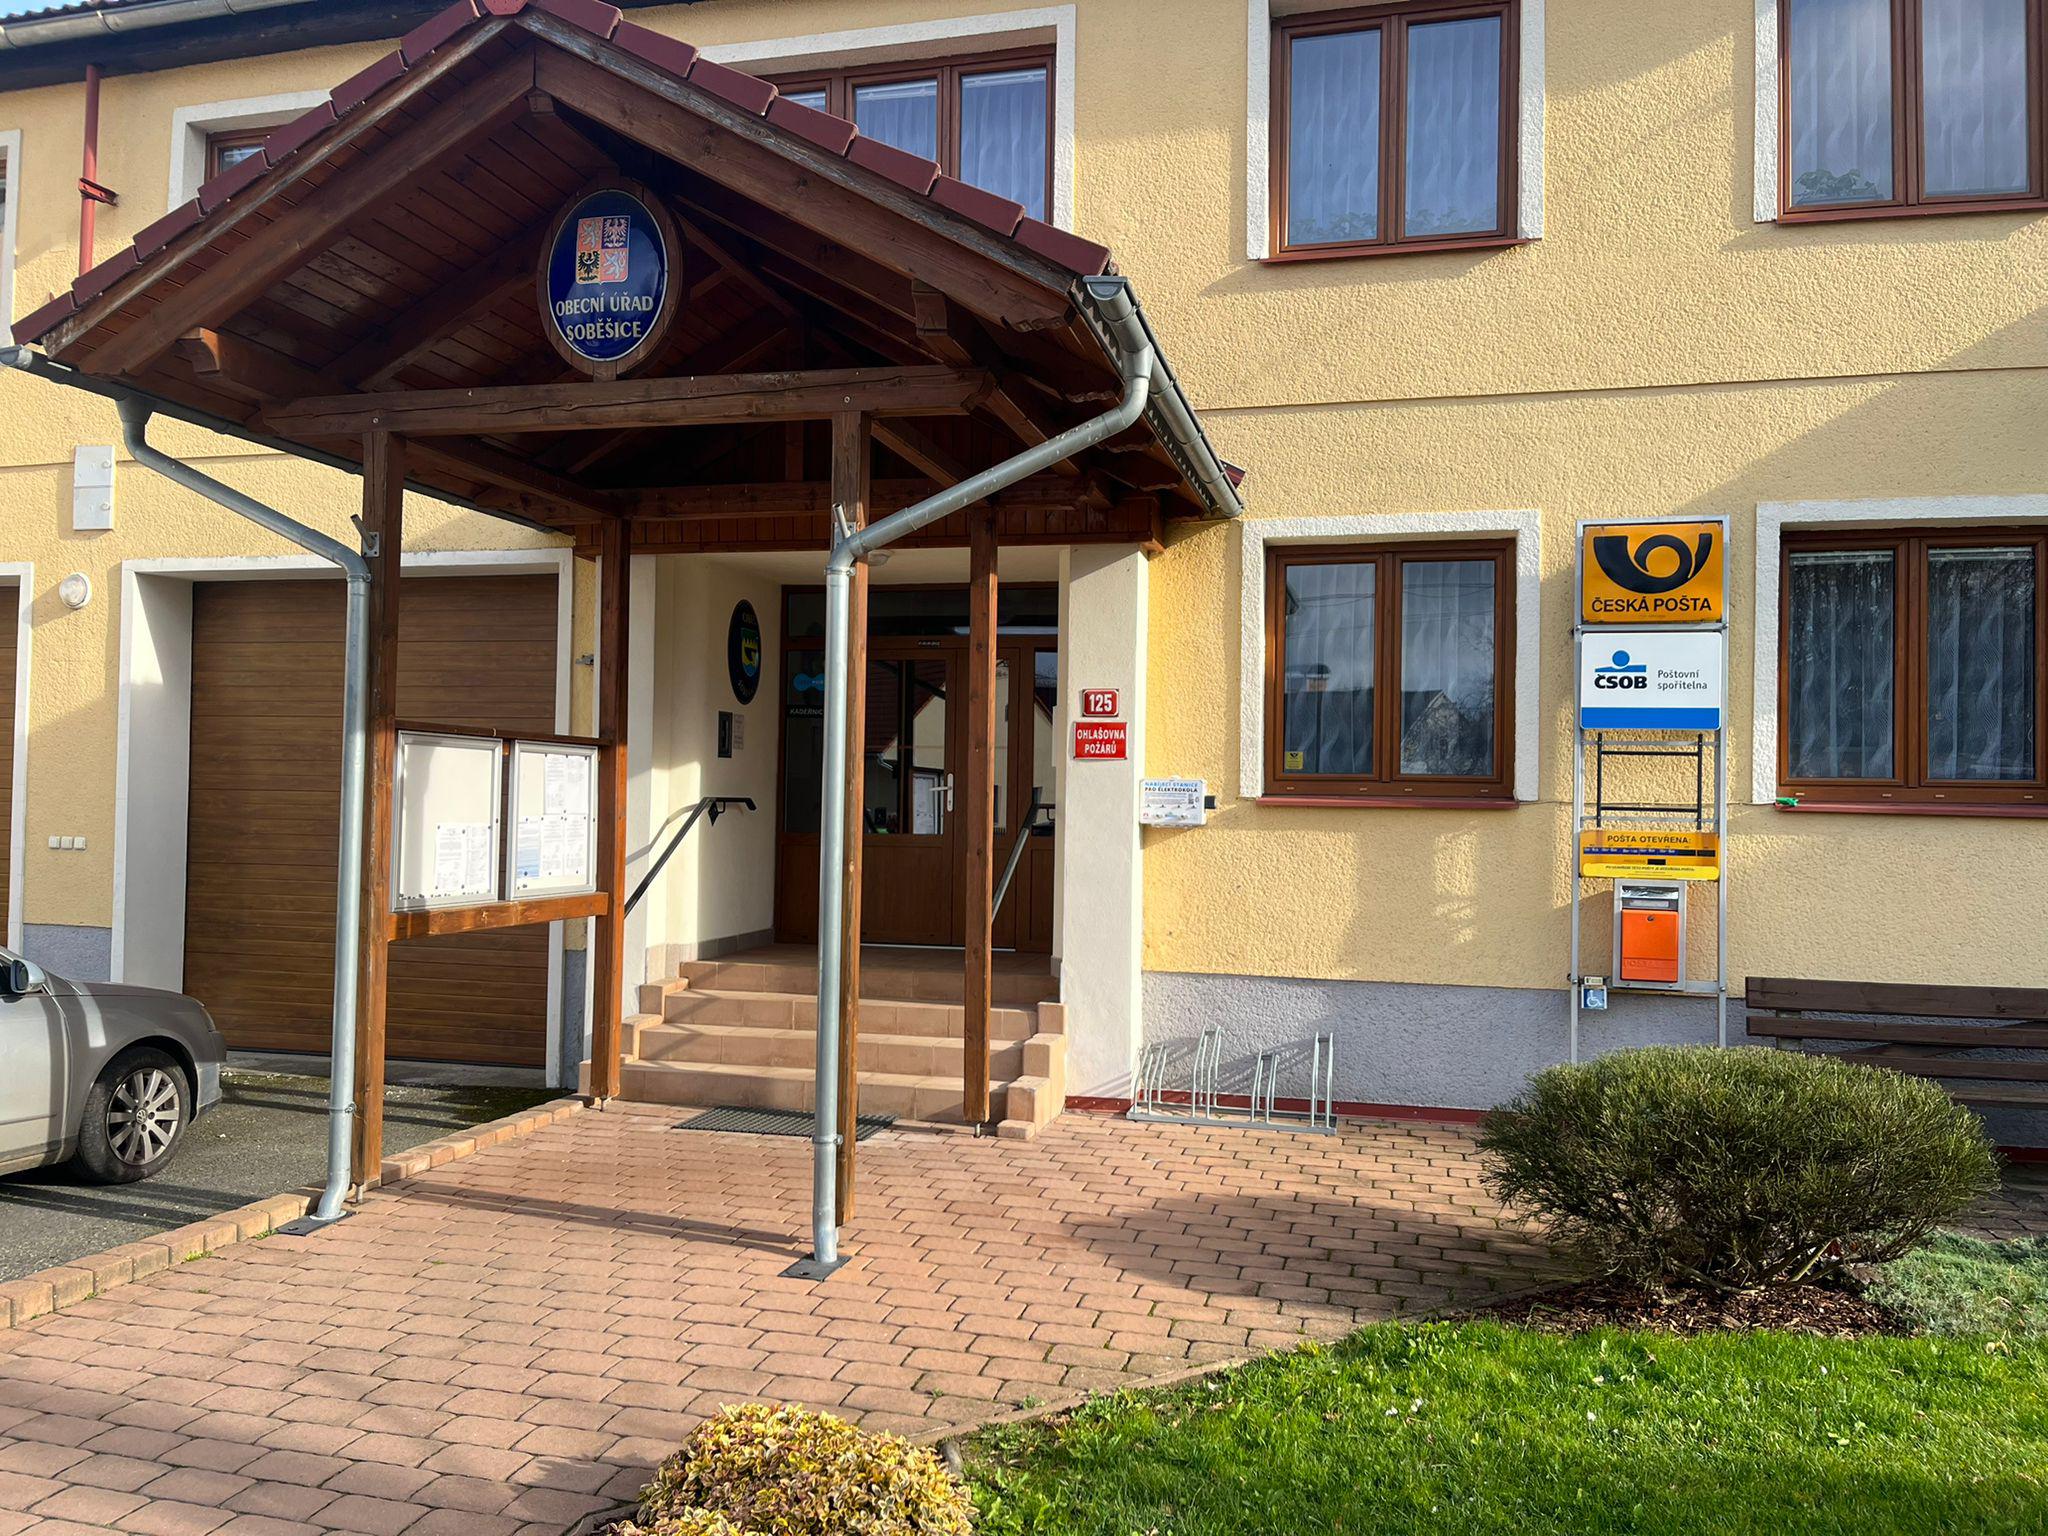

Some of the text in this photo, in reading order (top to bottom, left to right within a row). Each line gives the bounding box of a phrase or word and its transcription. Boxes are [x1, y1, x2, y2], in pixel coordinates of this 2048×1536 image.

[556, 291, 654, 317] OBECNÍ ÚŘAD
[566, 317, 642, 341] SOBĚŠICE
[1591, 595, 1712, 613] ČESKÁ POŠTA
[1594, 673, 1648, 690] ČSOB
[1657, 669, 1700, 679] Poštovní
[1657, 680, 1708, 691] spořitelna
[1088, 693, 1113, 712] 125
[1076, 726, 1126, 740] OHLAŠOVNA
[1084, 740, 1117, 755] POŽÁRŮ
[1607, 834, 1637, 843] POŠTA
